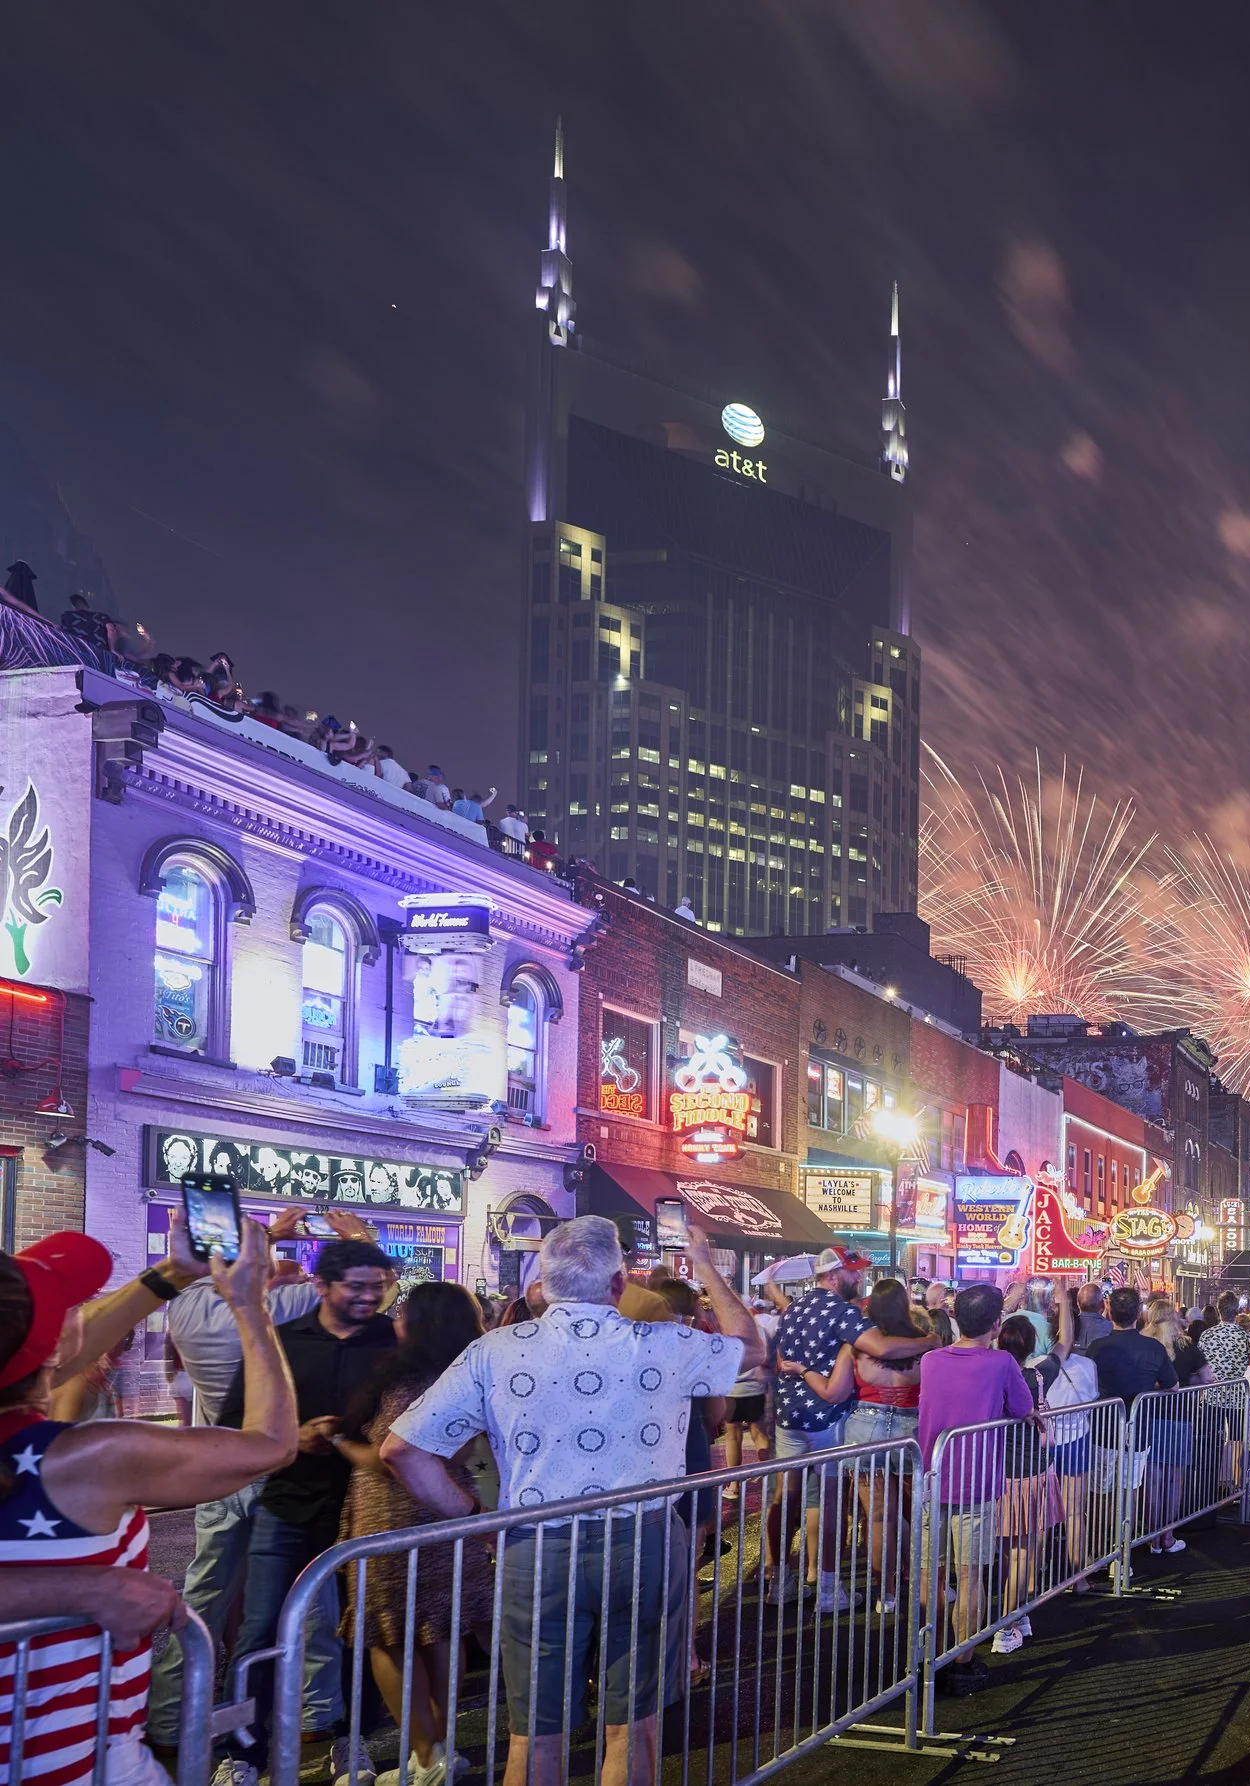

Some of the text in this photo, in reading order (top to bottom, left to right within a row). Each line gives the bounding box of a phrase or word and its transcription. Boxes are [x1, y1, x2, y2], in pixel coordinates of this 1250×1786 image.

[714, 449, 768, 484] at&t
[411, 913, 469, 928] World Famous
[670, 1092, 750, 1112] SECOND
[672, 1110, 747, 1132] FIDDLE
[822, 1179, 855, 1188] LAYLA'S
[822, 1187, 856, 1197] WELCOME
[832, 1196, 842, 1204] TO
[818, 1203, 858, 1213] NASHVILLE
[957, 1204, 1015, 1213] WESTERN
[965, 1213, 1008, 1222] WORLD
[958, 1223, 1001, 1234] HOME of
[1114, 1213, 1174, 1240] STAGE
[387, 1224, 446, 1243] WORLD FAMOUS
[1036, 1194, 1053, 1271] JACKS
[1052, 1258, 1102, 1269] BAR-B-QUE
